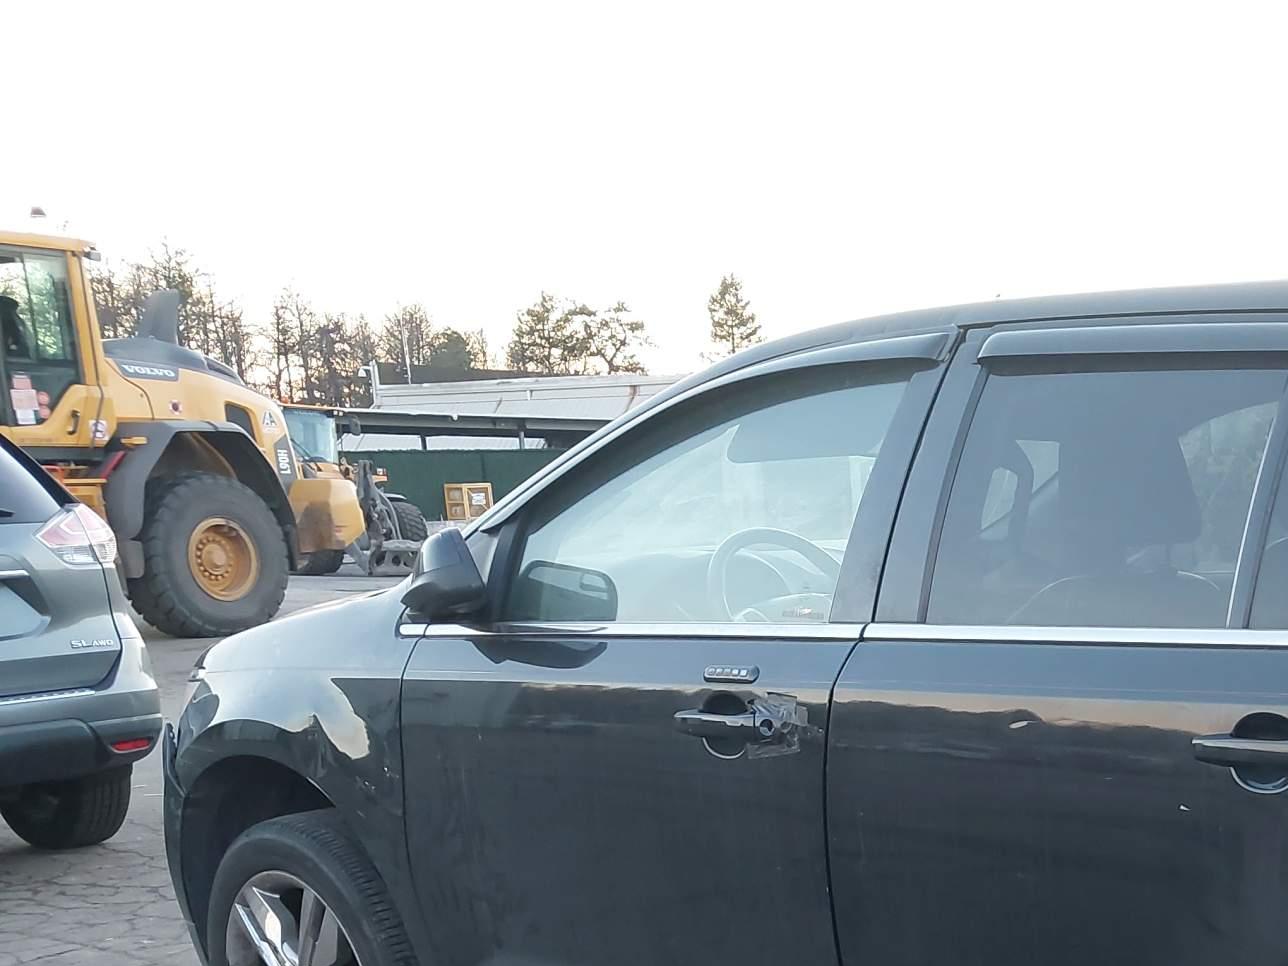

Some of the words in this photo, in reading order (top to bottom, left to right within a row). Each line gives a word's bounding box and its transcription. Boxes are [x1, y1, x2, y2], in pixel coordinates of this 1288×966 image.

[120, 364, 176, 378] VOLVO
[277, 449, 292, 475] L90H
[71, 639, 93, 649] SL
